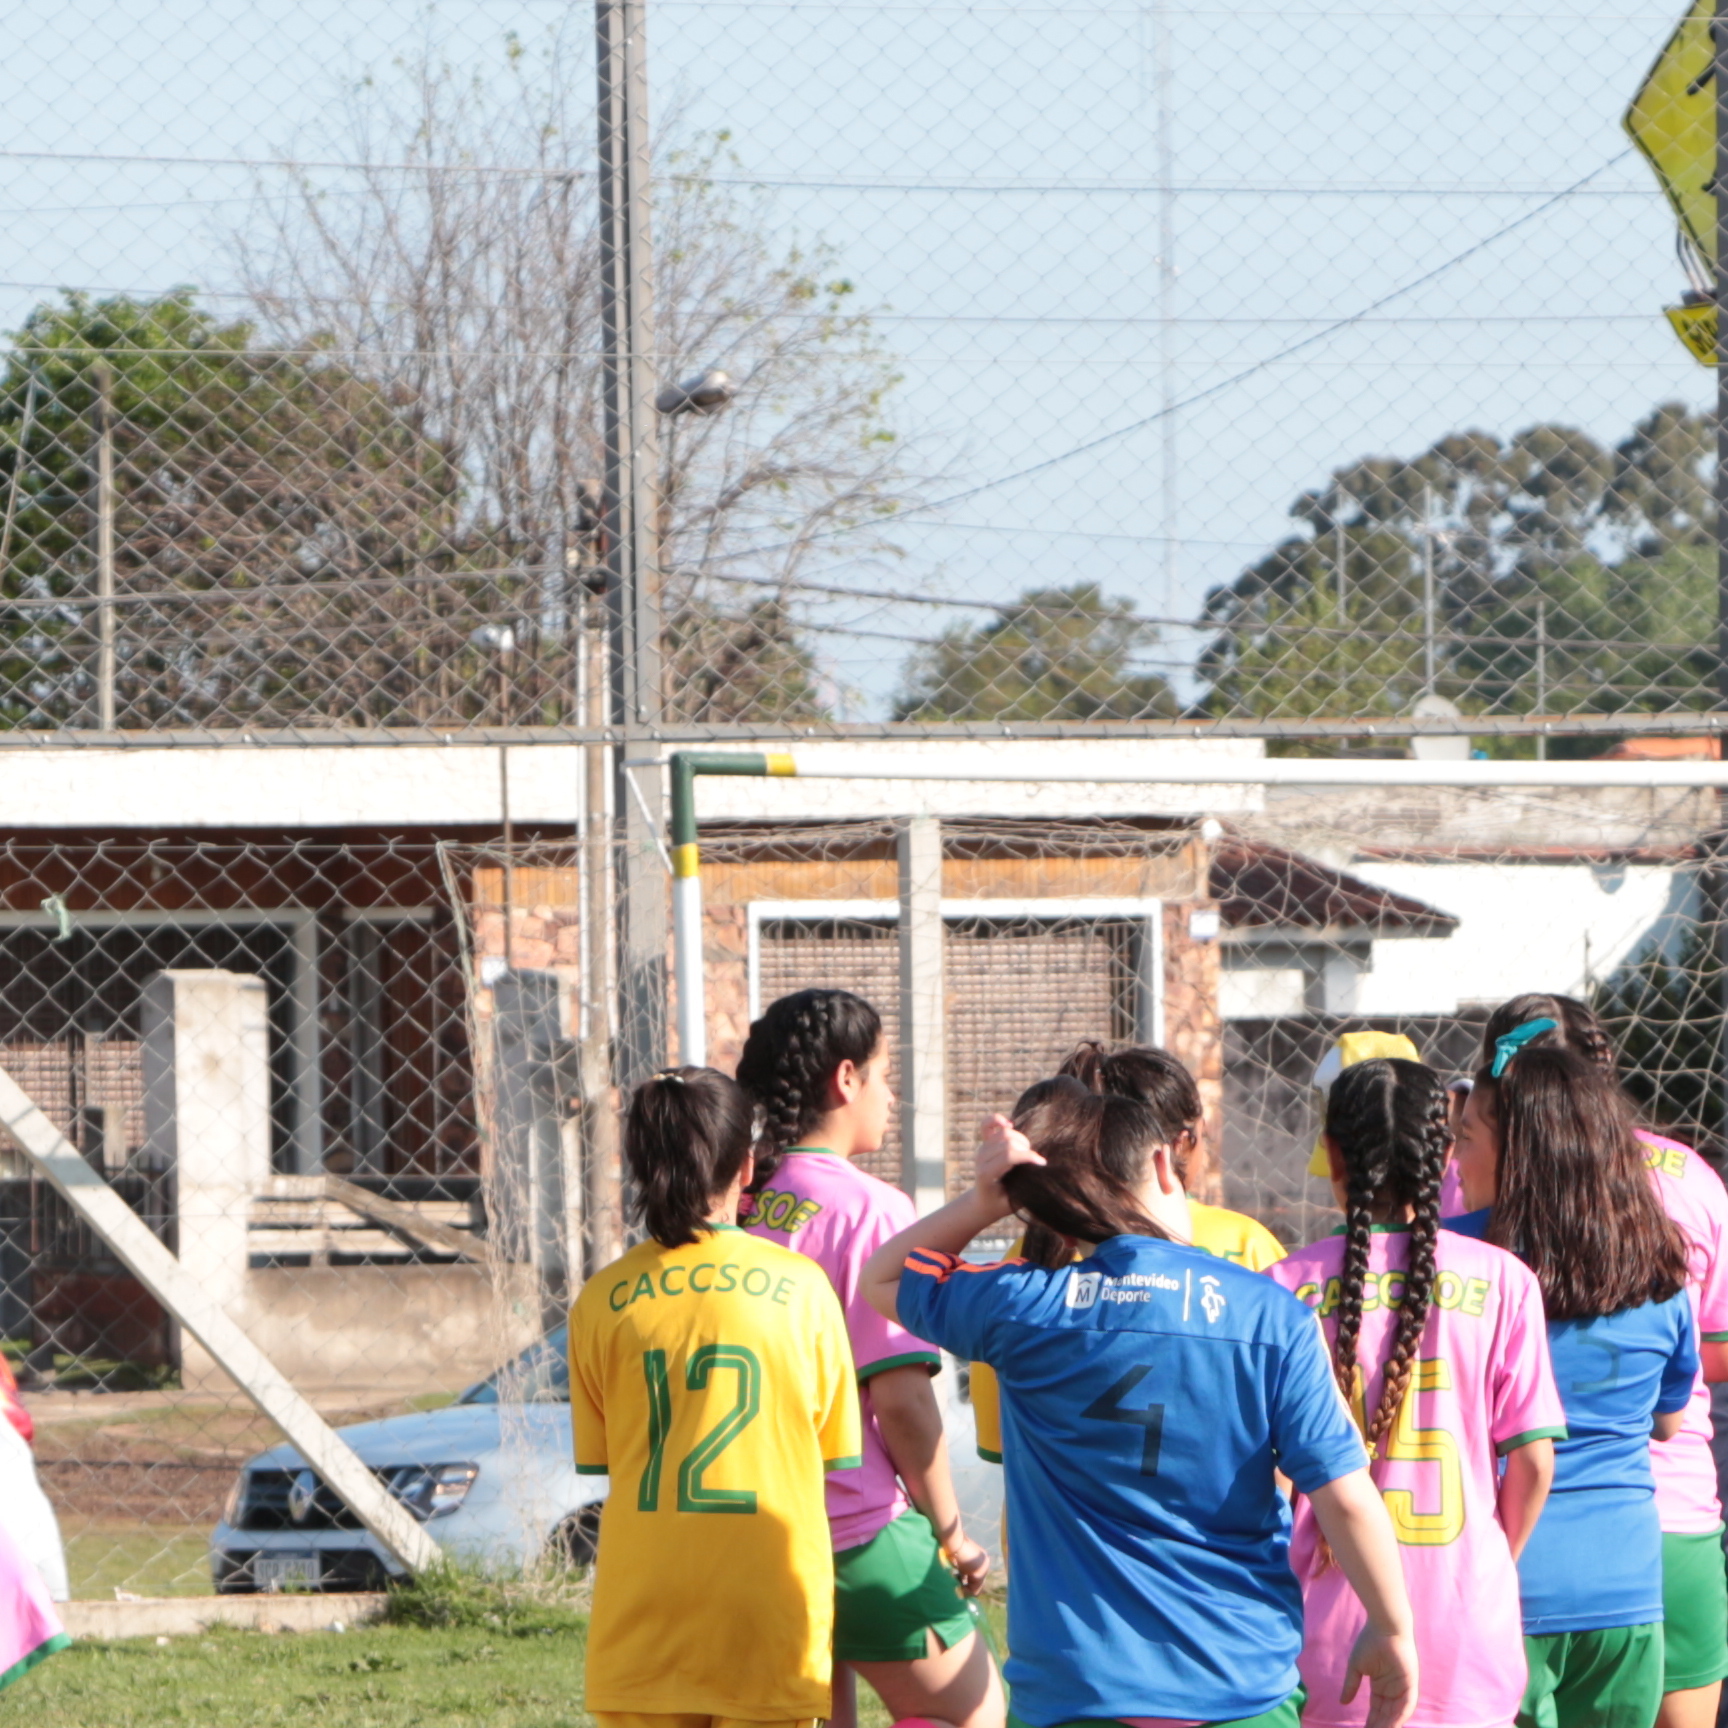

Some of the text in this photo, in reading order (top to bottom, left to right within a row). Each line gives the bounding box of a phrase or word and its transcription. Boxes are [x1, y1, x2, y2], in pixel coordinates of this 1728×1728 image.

[609, 1263, 796, 1312] CACCSOE
[1100, 1288, 1152, 1305] Deporte
[1294, 1270, 1491, 1317] CACCOE
[638, 1344, 762, 1514] 12
[1079, 1364, 1165, 1476] 4
